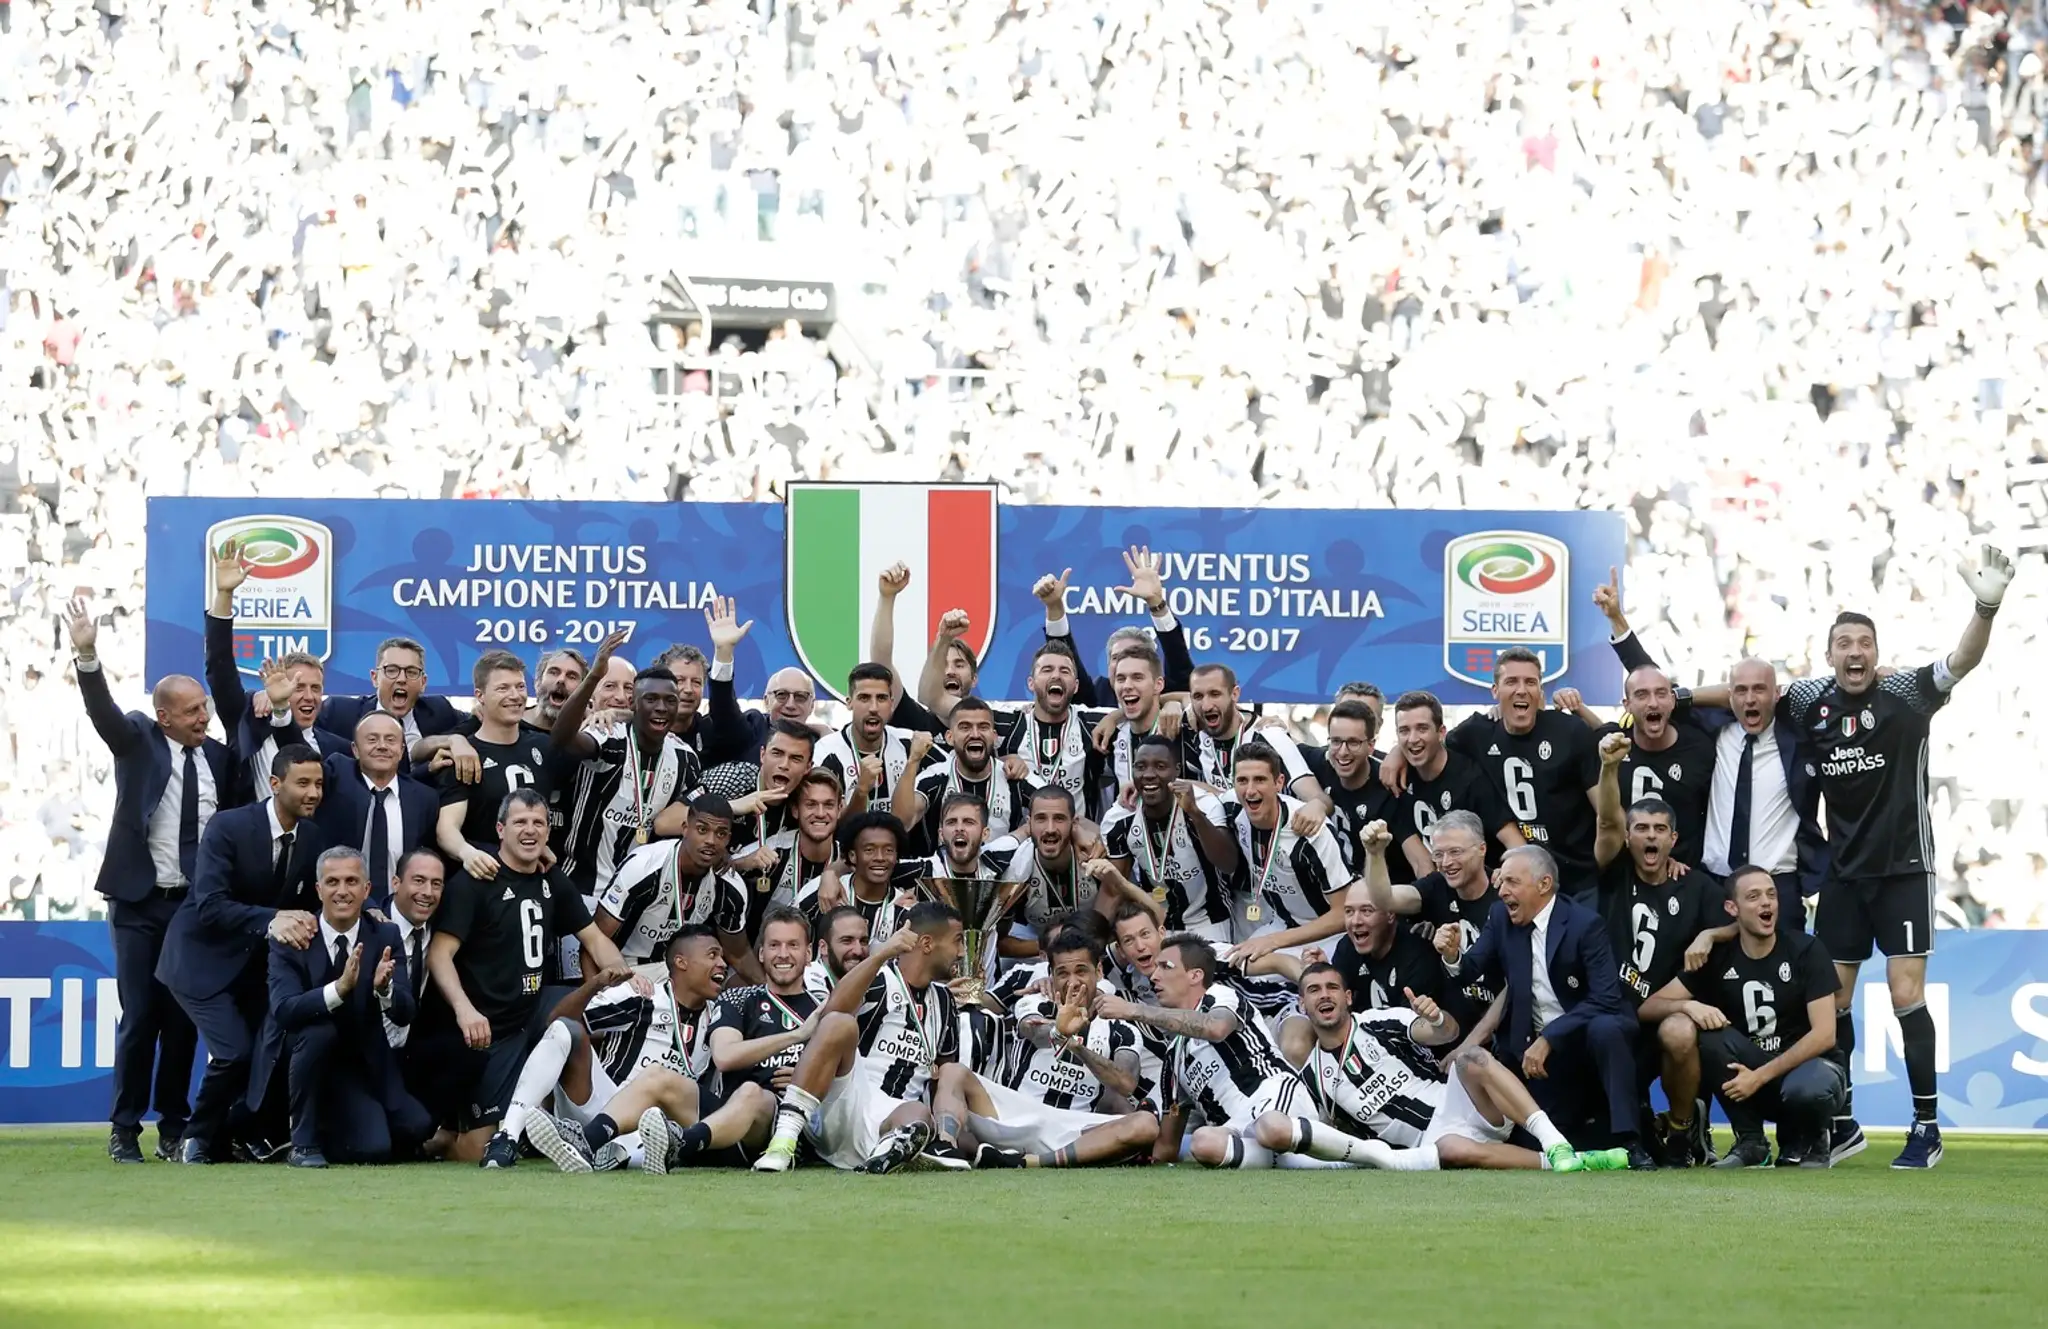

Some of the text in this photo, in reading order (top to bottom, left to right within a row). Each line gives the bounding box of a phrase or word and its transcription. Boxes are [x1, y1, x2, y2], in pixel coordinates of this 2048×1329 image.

[466, 544, 647, 574] JUVENTUS
[293, 596, 312, 618] A
[392, 577, 721, 609] CAMPIONE D'ITALIA
[1250, 587, 1384, 618] D'ITALIA
[475, 618, 548, 643] 2016
[1463, 609, 1549, 633] SERIE A
[259, 635, 308, 660] TIM
[1821, 753, 1885, 776] COMPASS
[1830, 746, 1866, 761] Jeep
[1503, 756, 1538, 821] 6
[520, 898, 543, 968] 6
[1902, 920, 1914, 952] 1
[1742, 980, 1777, 1038] 6
[1030, 1069, 1096, 1098] COMPASS
[1051, 1060, 1085, 1081] Jeep
[1185, 1061, 1203, 1086] Jeep
[1356, 1070, 1409, 1122] COMPASS
[1358, 1073, 1387, 1101] Jeep
